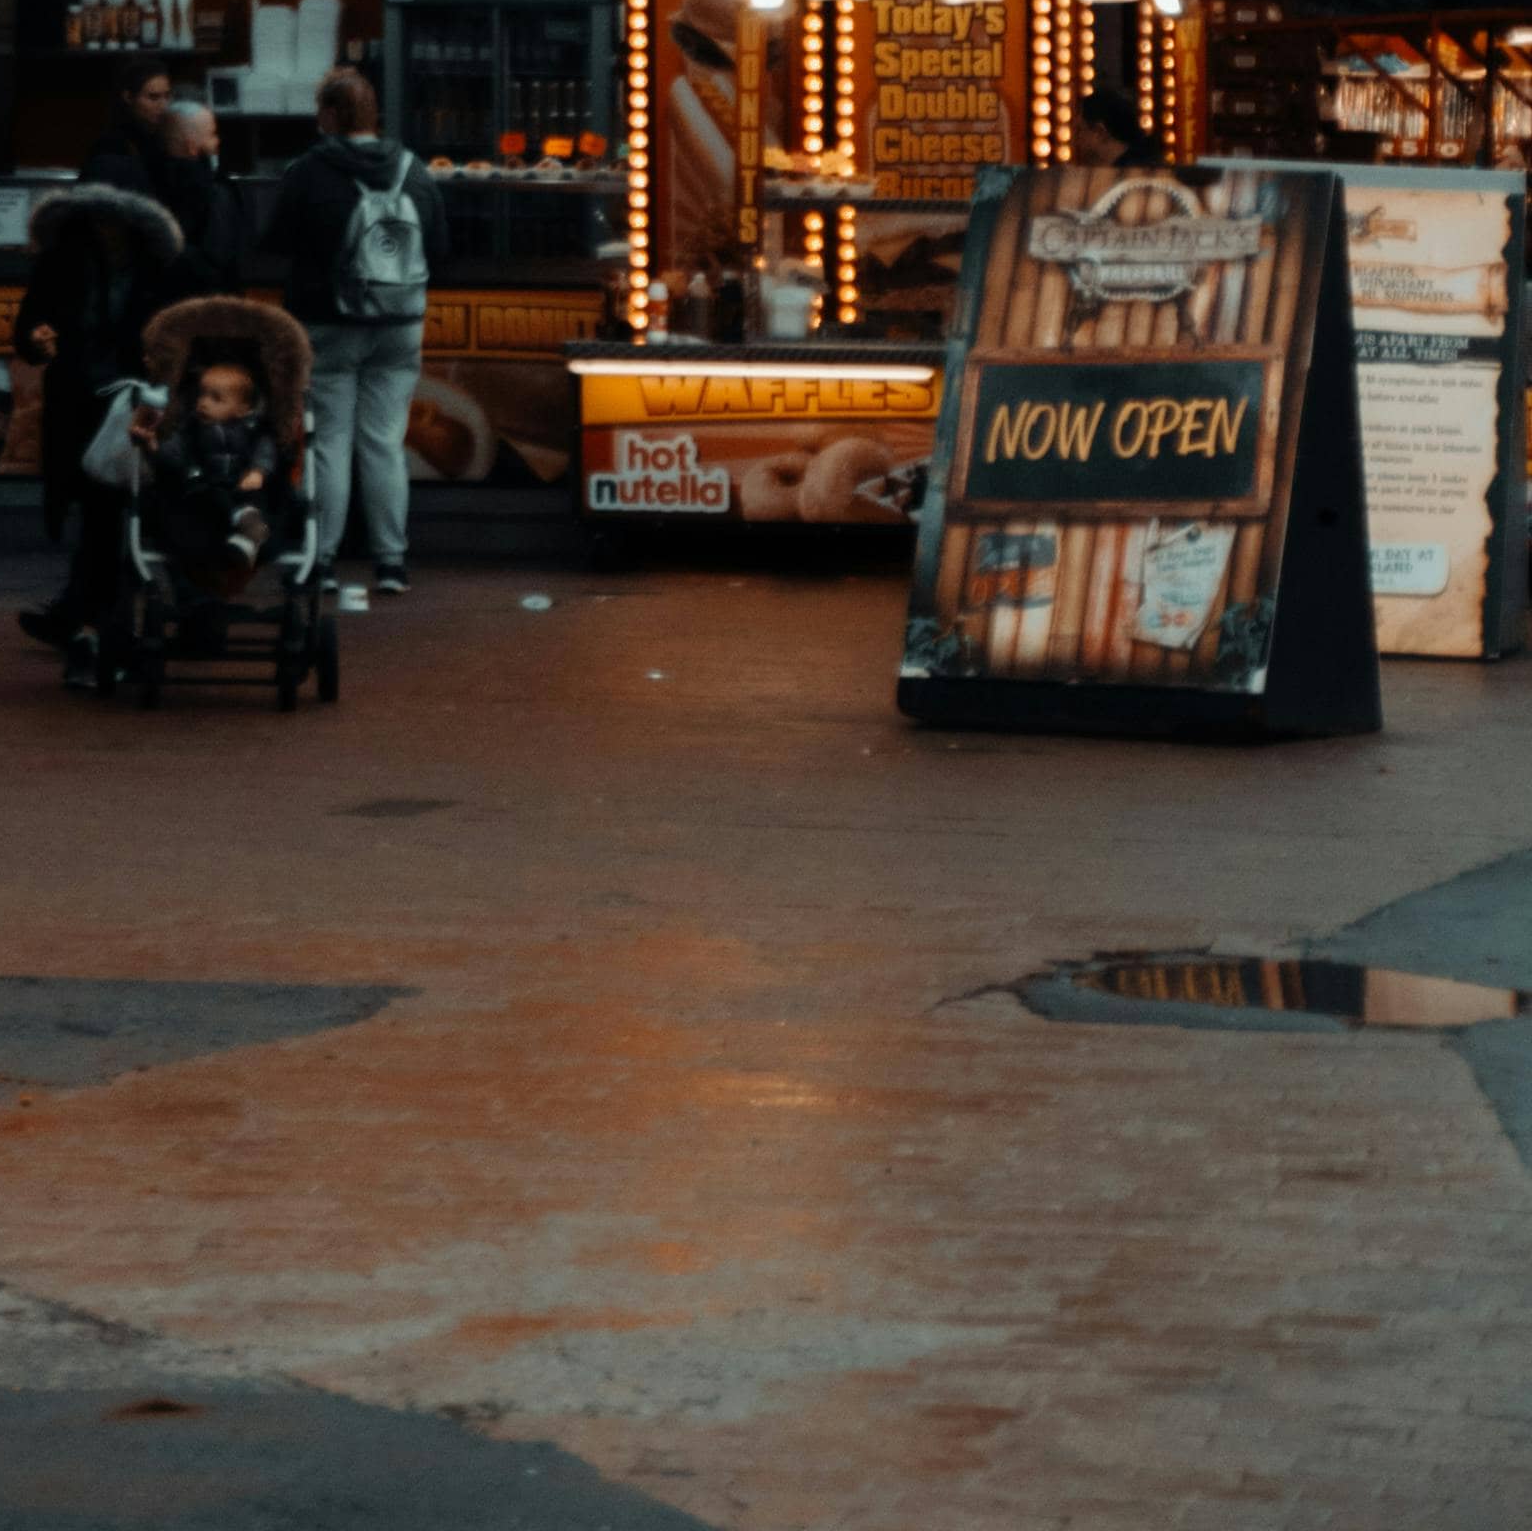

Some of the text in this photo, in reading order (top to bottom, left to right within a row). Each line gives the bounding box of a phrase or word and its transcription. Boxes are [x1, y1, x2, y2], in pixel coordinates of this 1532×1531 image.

[874, 41, 1004, 83] Special
[879, 84, 1000, 120] Double
[874, 126, 1005, 164] Cheese
[1357, 346, 1376, 358] AT
[1429, 336, 1469, 350] FROM
[639, 375, 935, 417] WAFFLES
[985, 394, 1250, 464] NOW OPEN
[627, 438, 691, 472] hot
[595, 474, 724, 507] nutella
